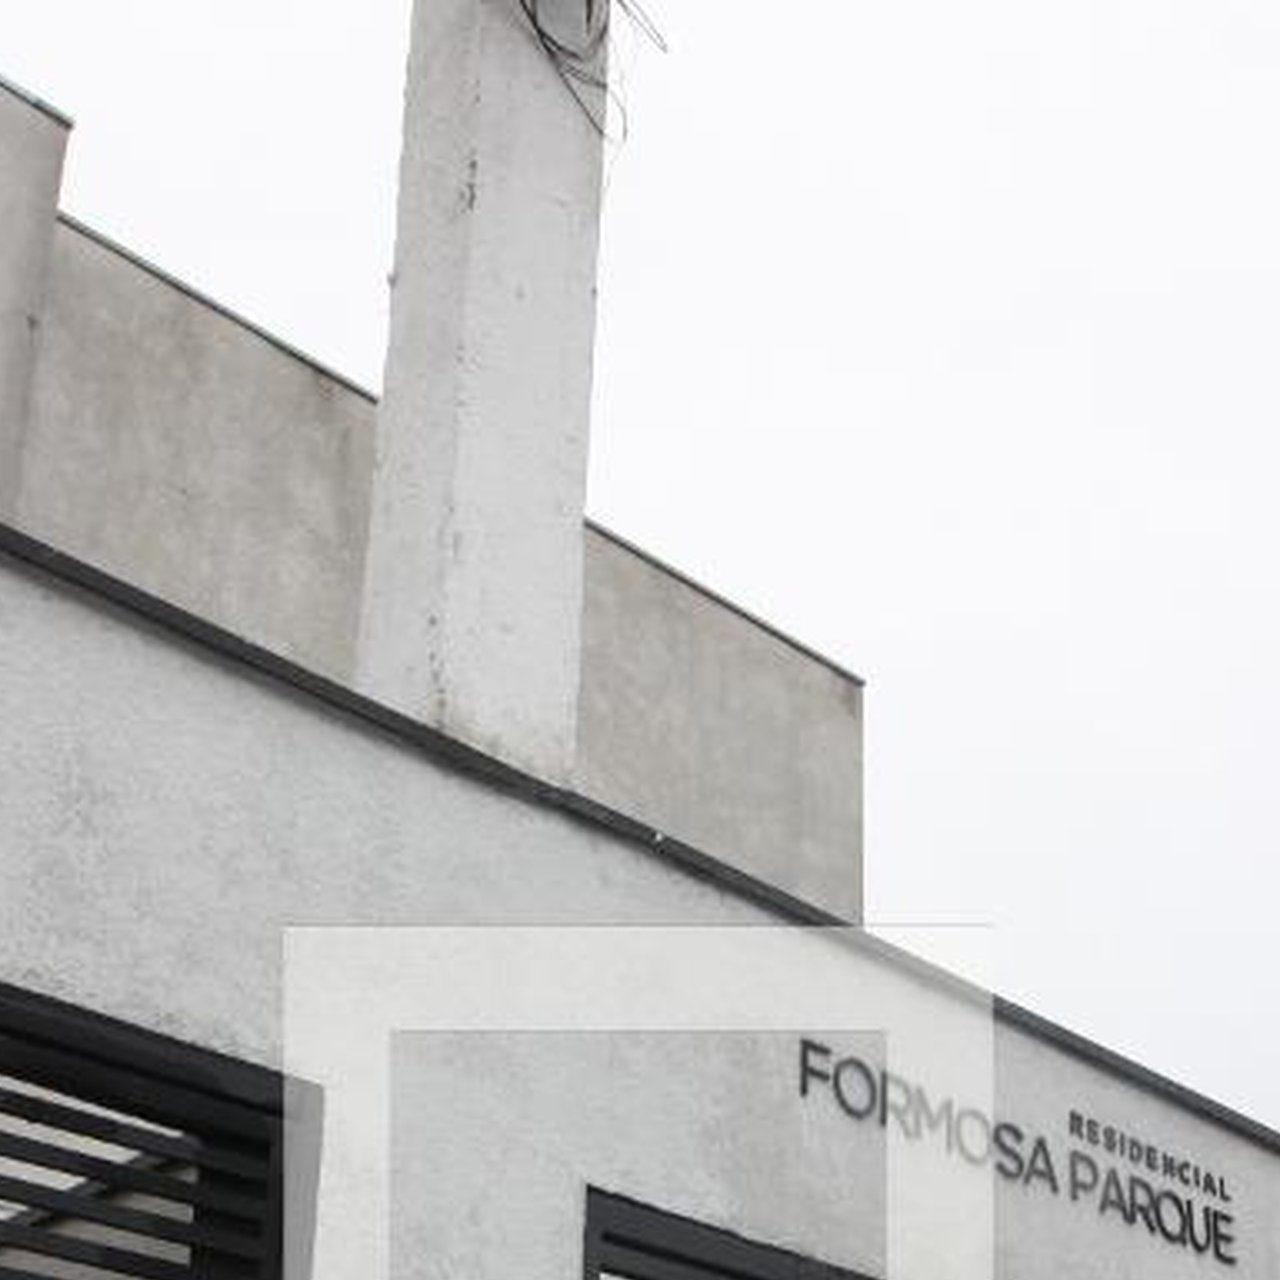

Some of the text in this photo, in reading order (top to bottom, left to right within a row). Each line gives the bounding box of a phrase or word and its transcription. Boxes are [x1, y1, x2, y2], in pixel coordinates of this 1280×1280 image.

[800, 1038, 1236, 1265] FORMOSA PARQUE
[1069, 1109, 1232, 1202] RESIDENCIAL
